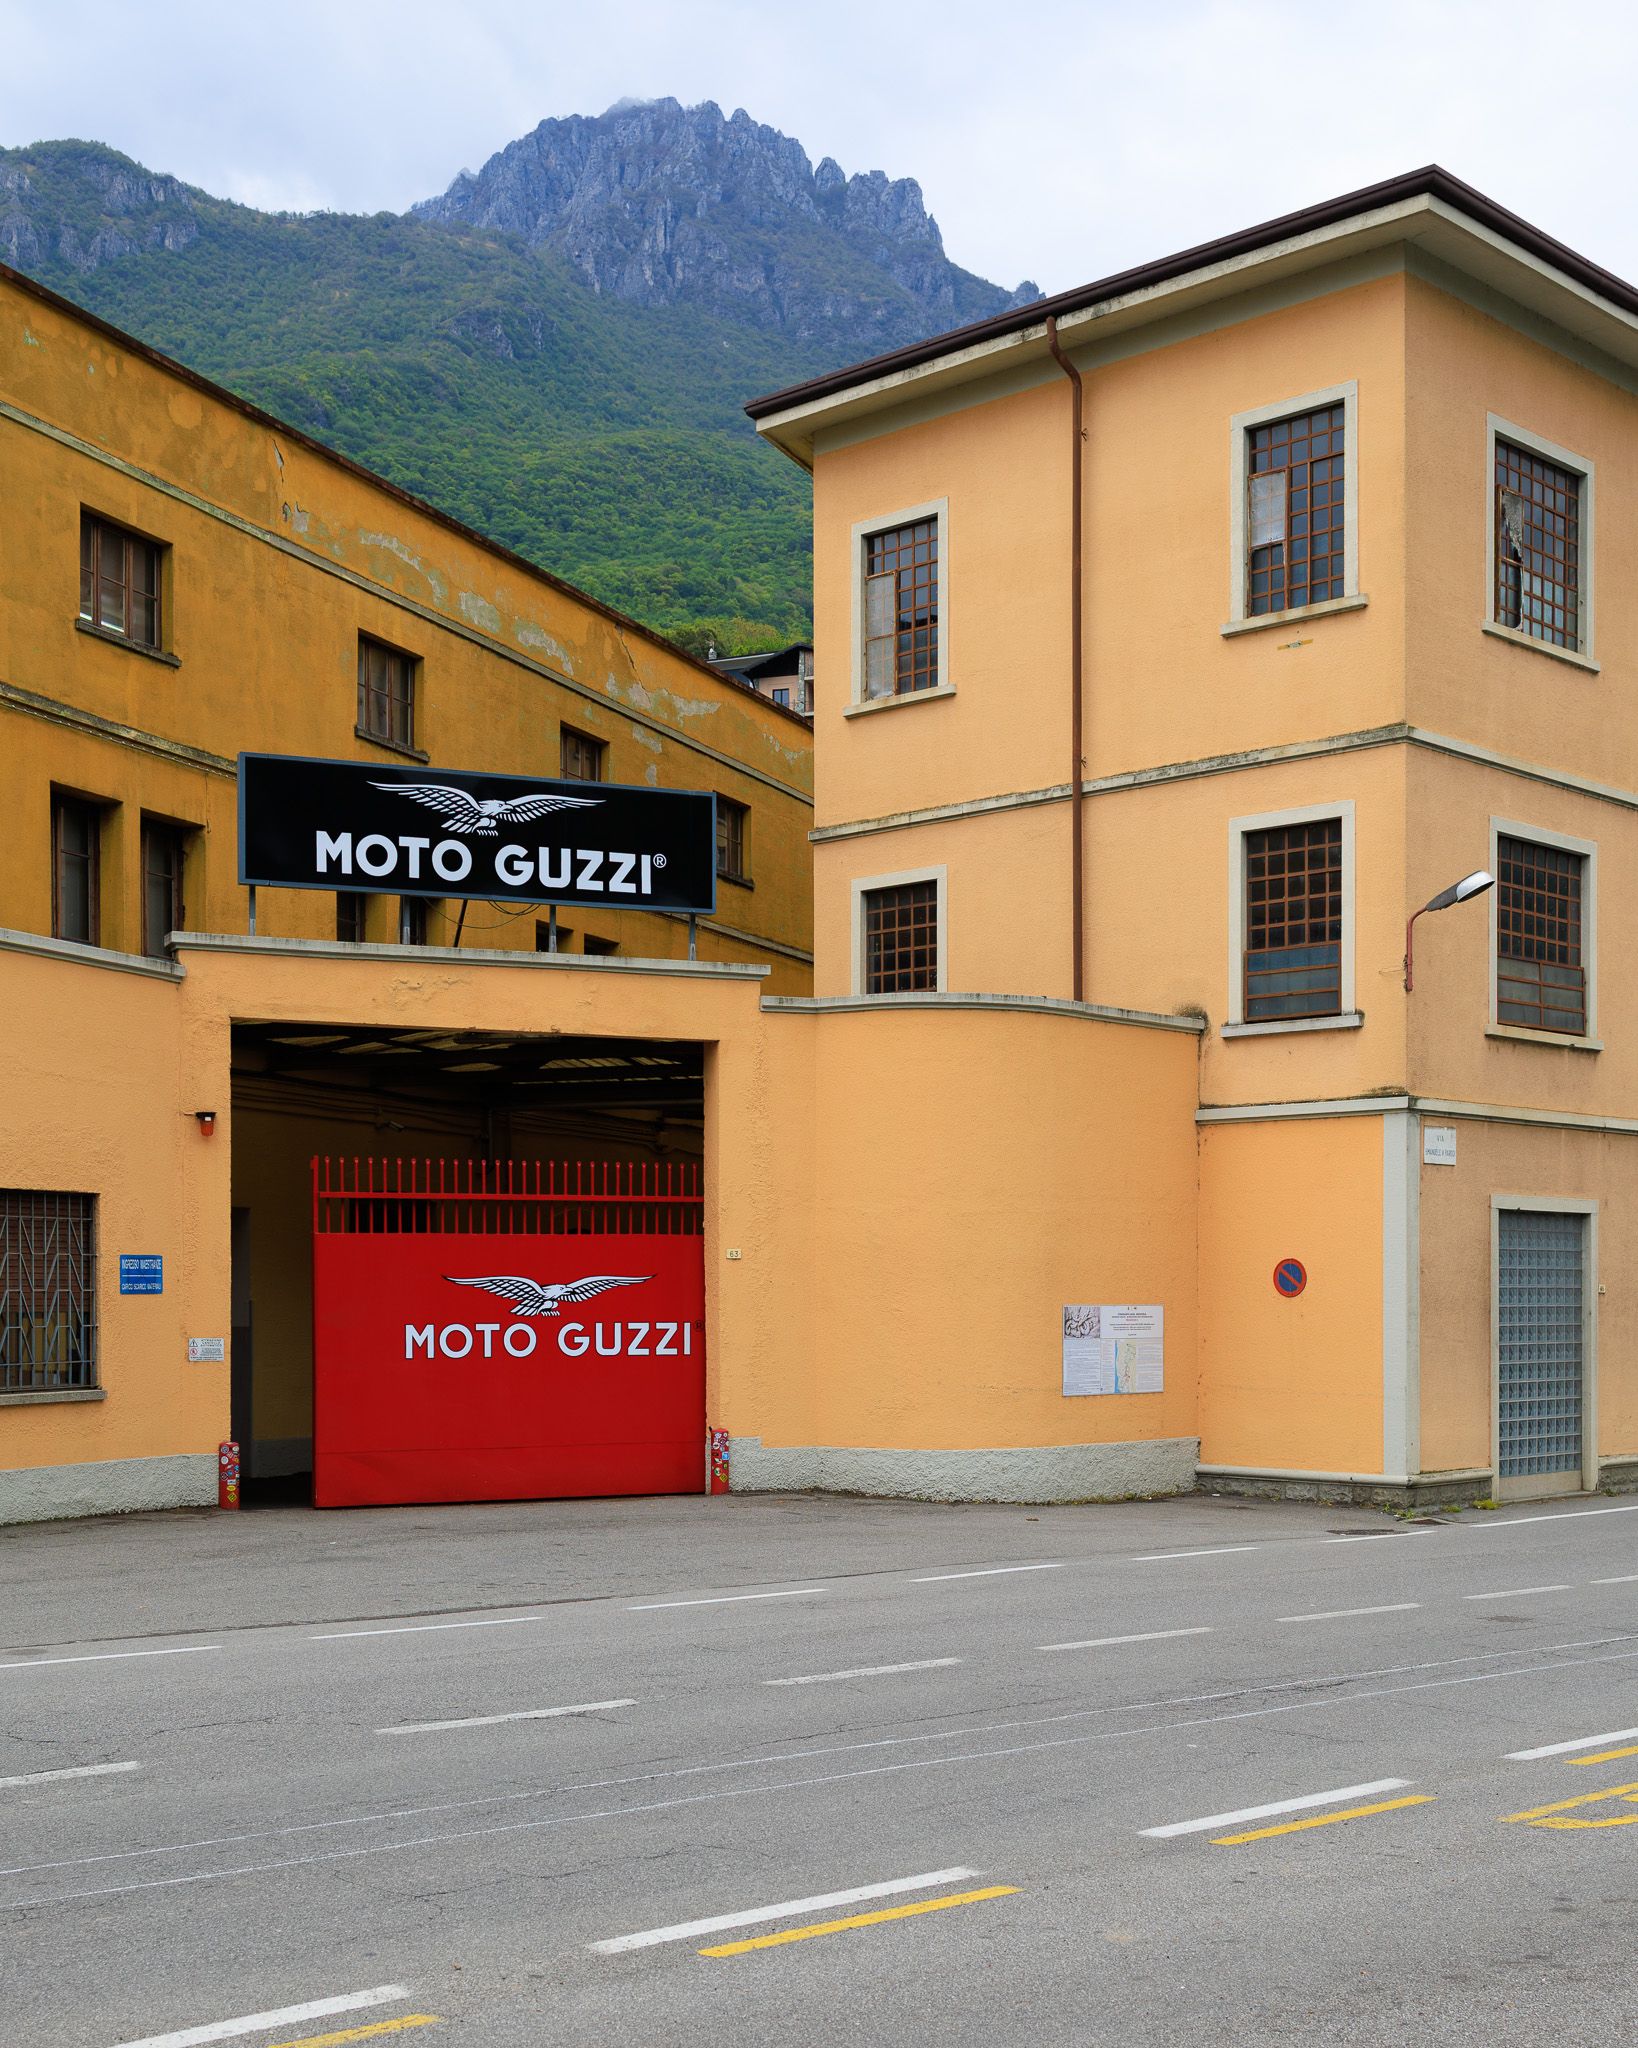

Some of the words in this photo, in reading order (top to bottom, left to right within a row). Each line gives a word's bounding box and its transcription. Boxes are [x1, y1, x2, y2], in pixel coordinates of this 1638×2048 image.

[316, 831, 473, 881] MOTO
[729, 1250, 739, 1258] 63
[405, 1323, 537, 1359] MOTO
